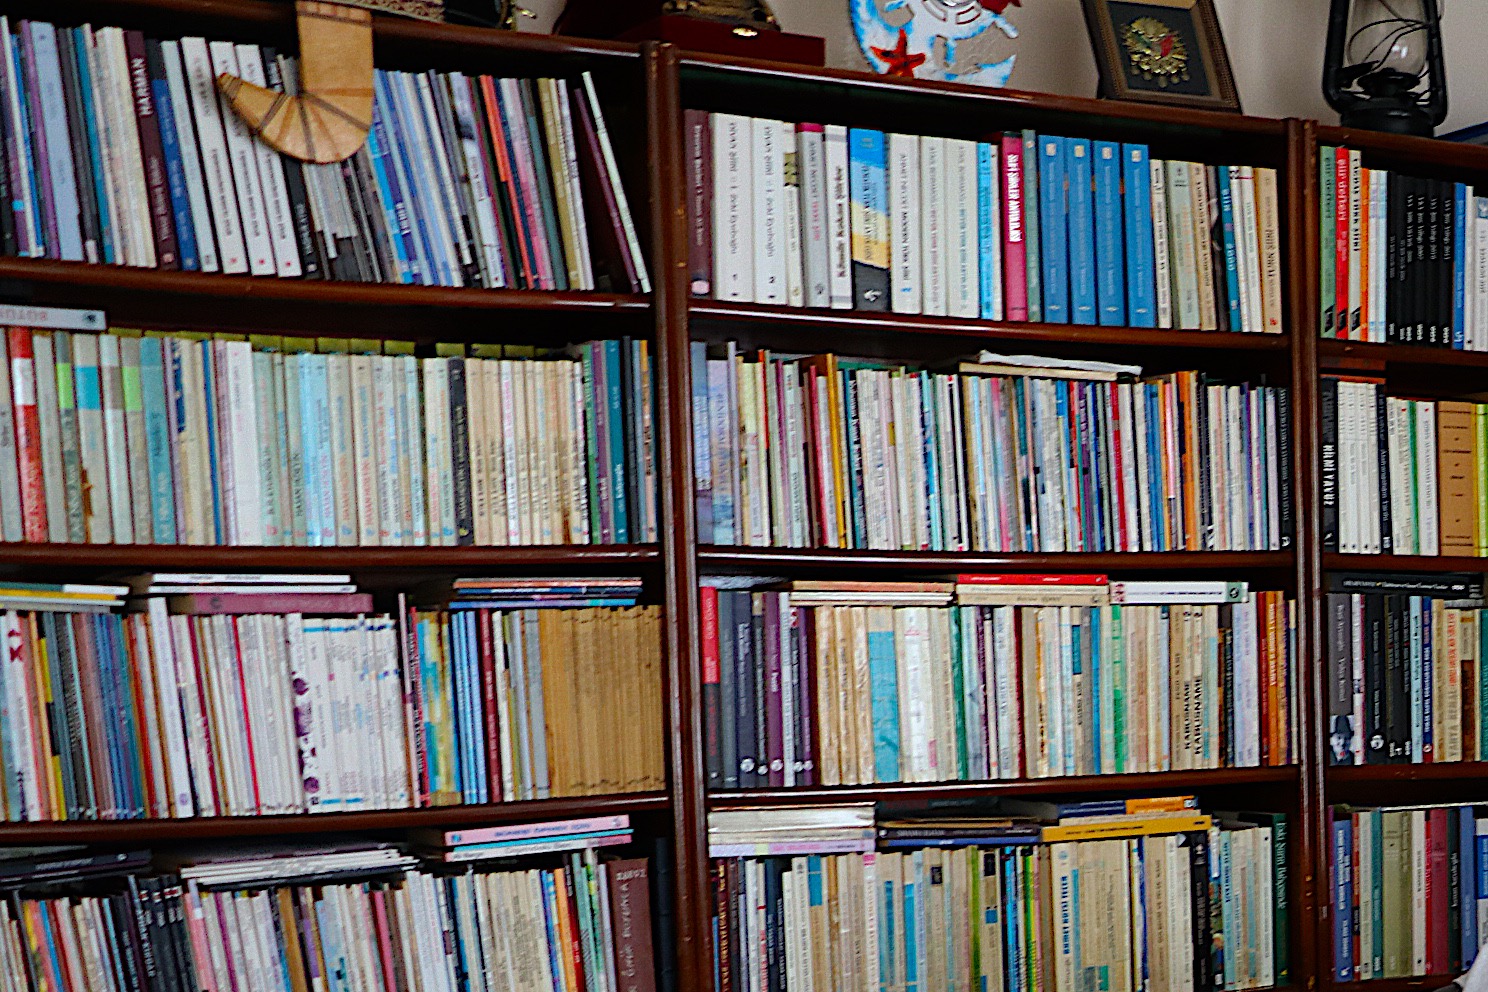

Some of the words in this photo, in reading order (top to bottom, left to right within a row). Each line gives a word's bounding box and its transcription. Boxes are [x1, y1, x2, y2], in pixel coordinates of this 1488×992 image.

[129, 57, 152, 116] HARMAN
[1322, 445, 1334, 471] HİLMİ
[1322, 474, 1334, 506] YAVUZ
